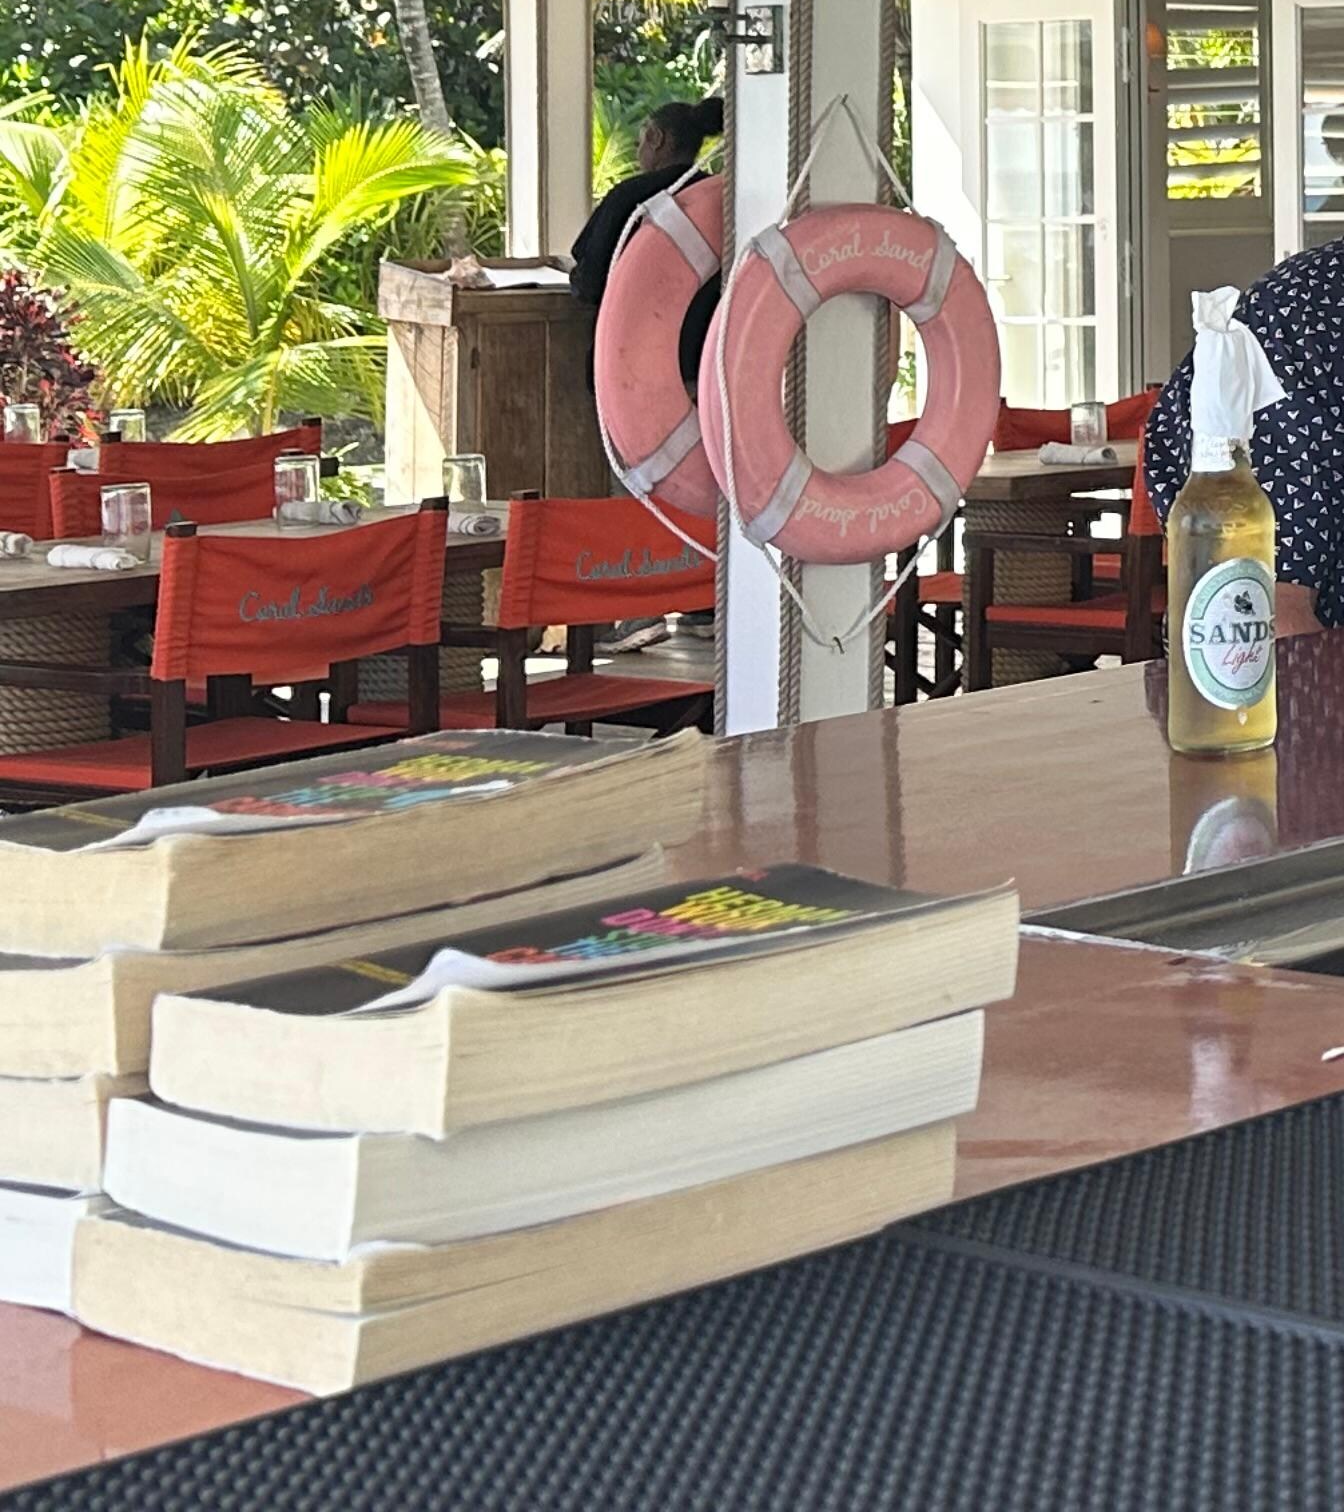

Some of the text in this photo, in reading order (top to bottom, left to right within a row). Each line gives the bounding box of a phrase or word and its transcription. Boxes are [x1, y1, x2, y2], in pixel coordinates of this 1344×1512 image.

[802, 232, 864, 275] Coral
[866, 488, 928, 534] Coral
[1222, 640, 1264, 675] Light
